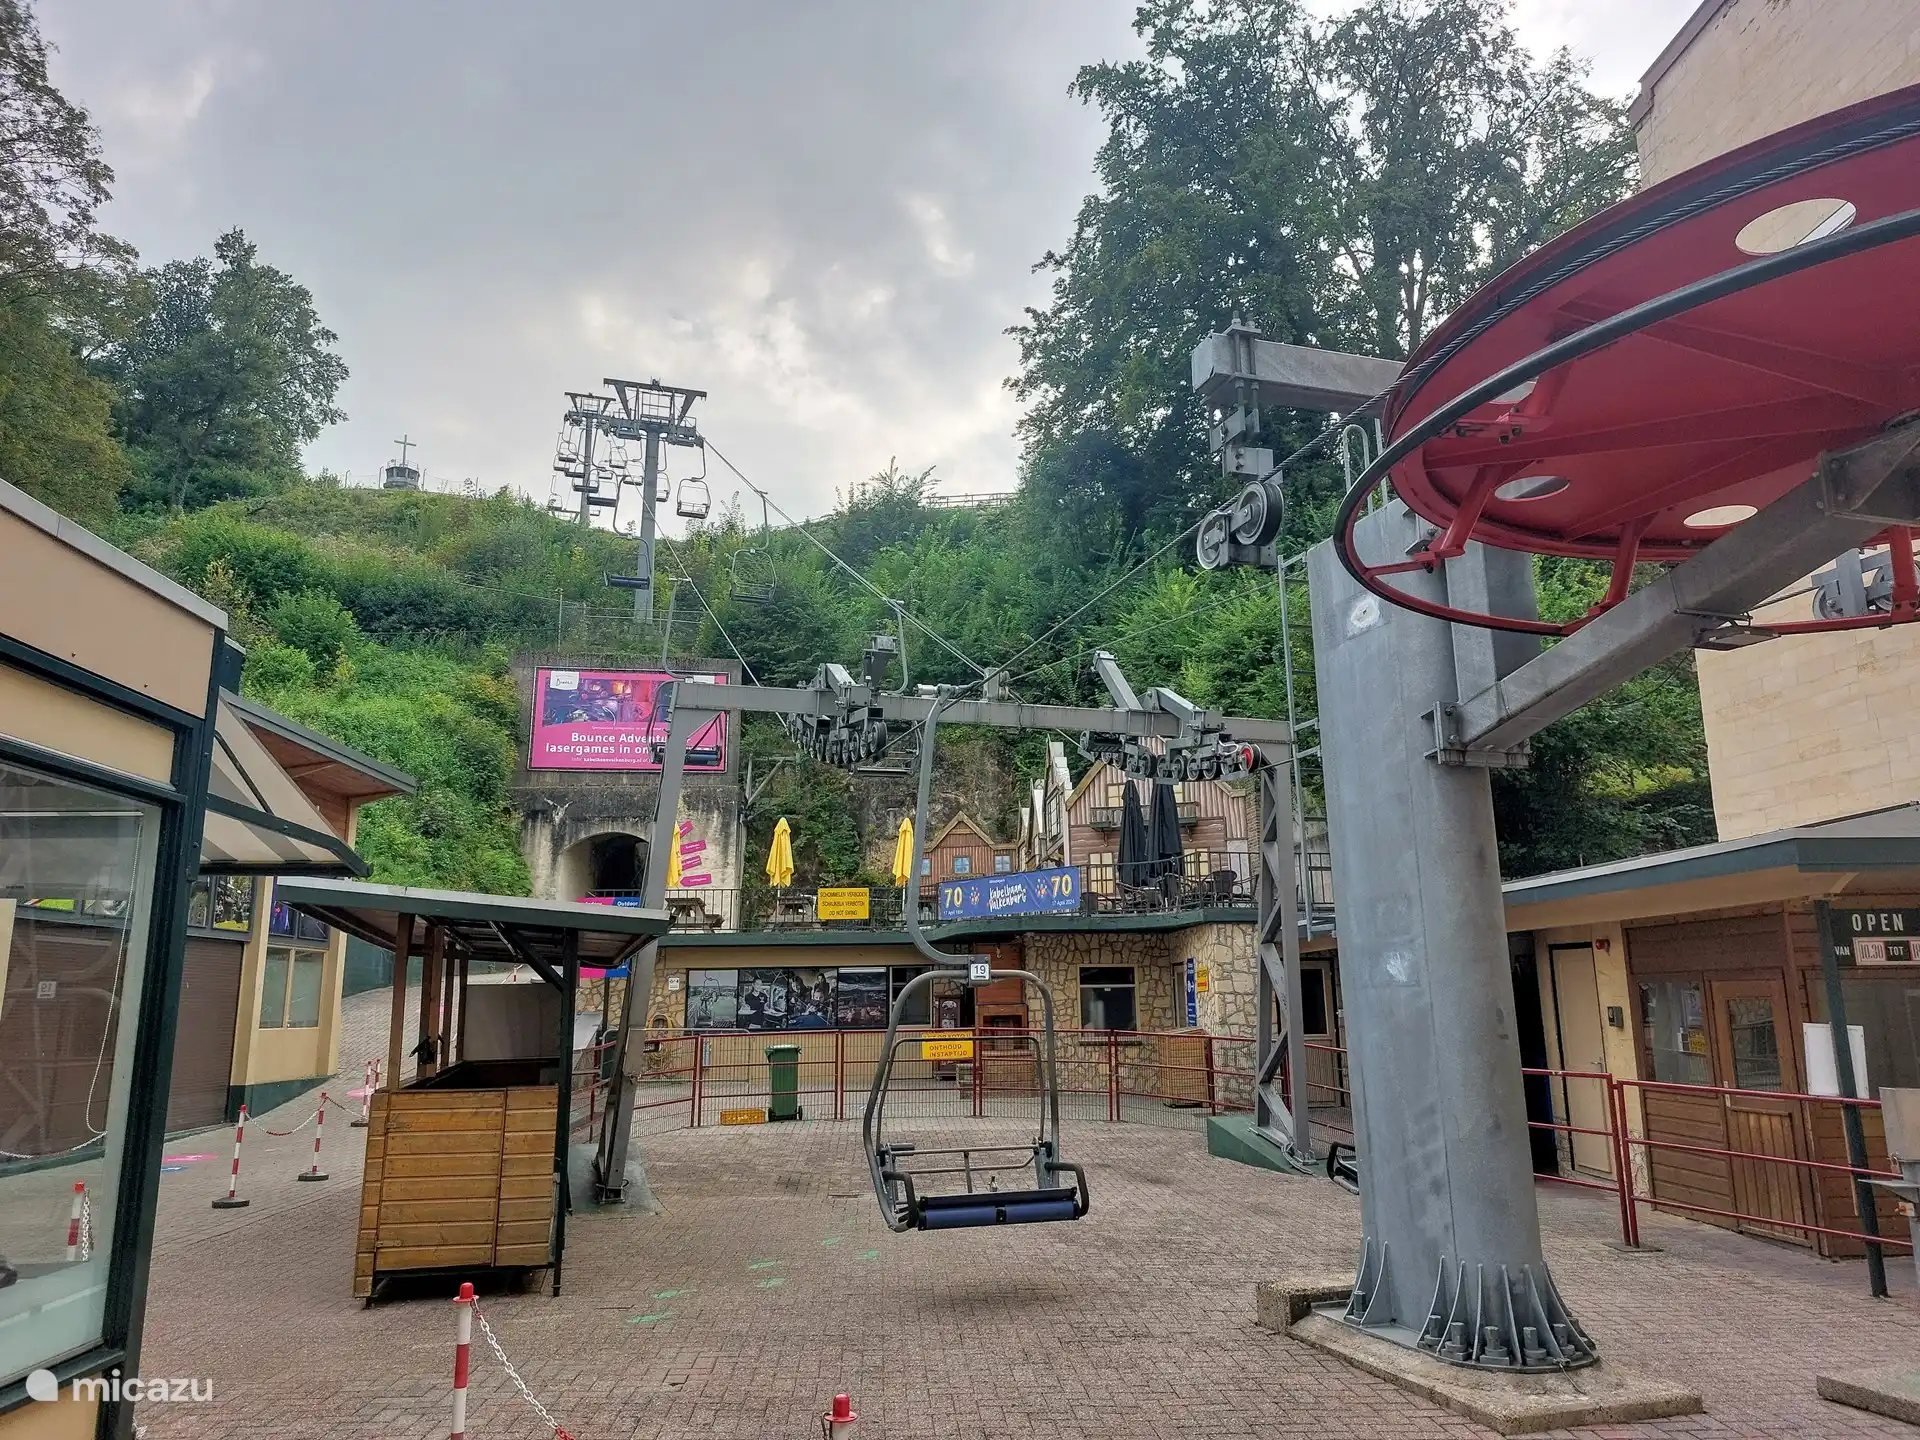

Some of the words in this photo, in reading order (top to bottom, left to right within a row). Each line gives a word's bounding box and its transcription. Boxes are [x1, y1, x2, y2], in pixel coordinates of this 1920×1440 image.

[571, 732, 615, 743] Bounce
[545, 743, 615, 755] lasergames
[620, 744, 630, 754] in
[1050, 873, 1073, 897] 70
[944, 886, 963, 909] 70
[1851, 913, 1904, 931] OPEN
[1834, 946, 1850, 956] VAN
[1887, 946, 1904, 956] TOT
[974, 965, 986, 975] 19
[928, 1043, 962, 1051] ONTHOUD
